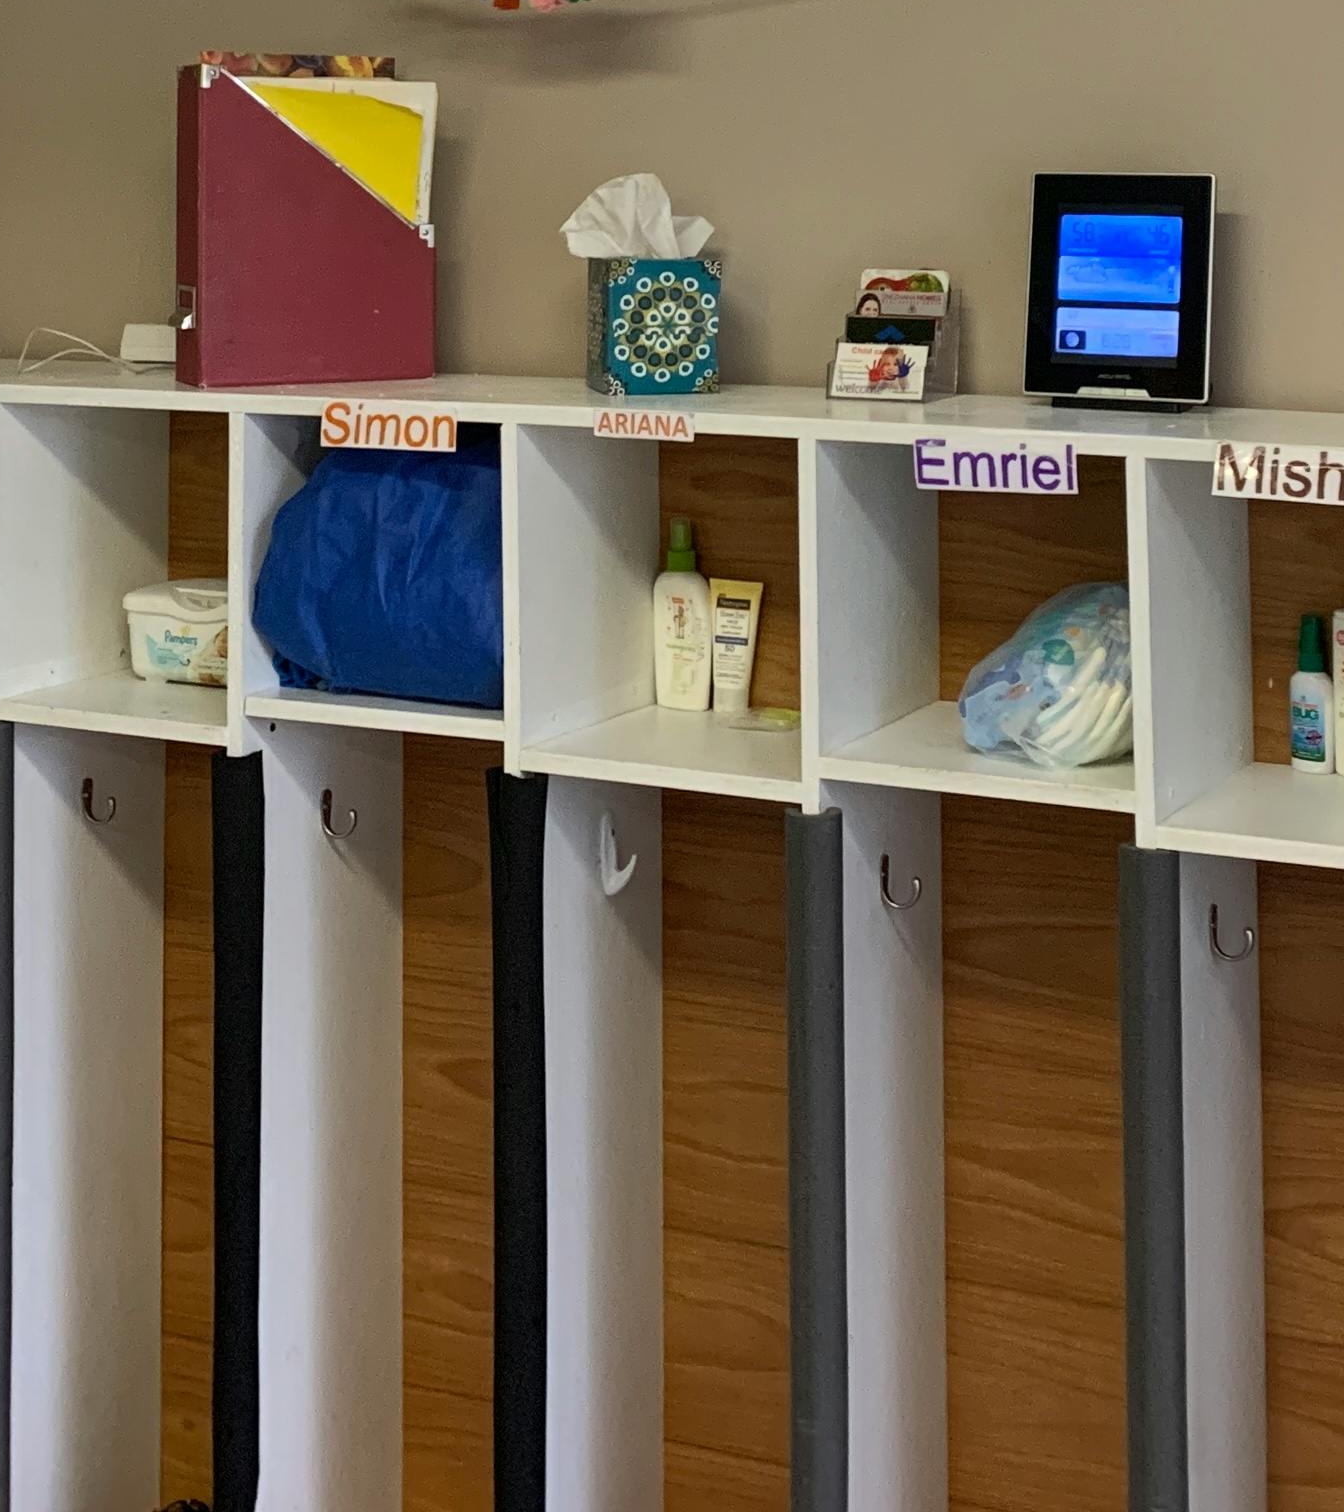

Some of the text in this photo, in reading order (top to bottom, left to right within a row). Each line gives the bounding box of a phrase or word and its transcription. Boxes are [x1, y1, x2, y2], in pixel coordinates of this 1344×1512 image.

[322, 401, 455, 449] Simon
[598, 411, 689, 439] ARIANA
[915, 439, 1076, 491] Emriel
[164, 629, 198, 646] Pampers
